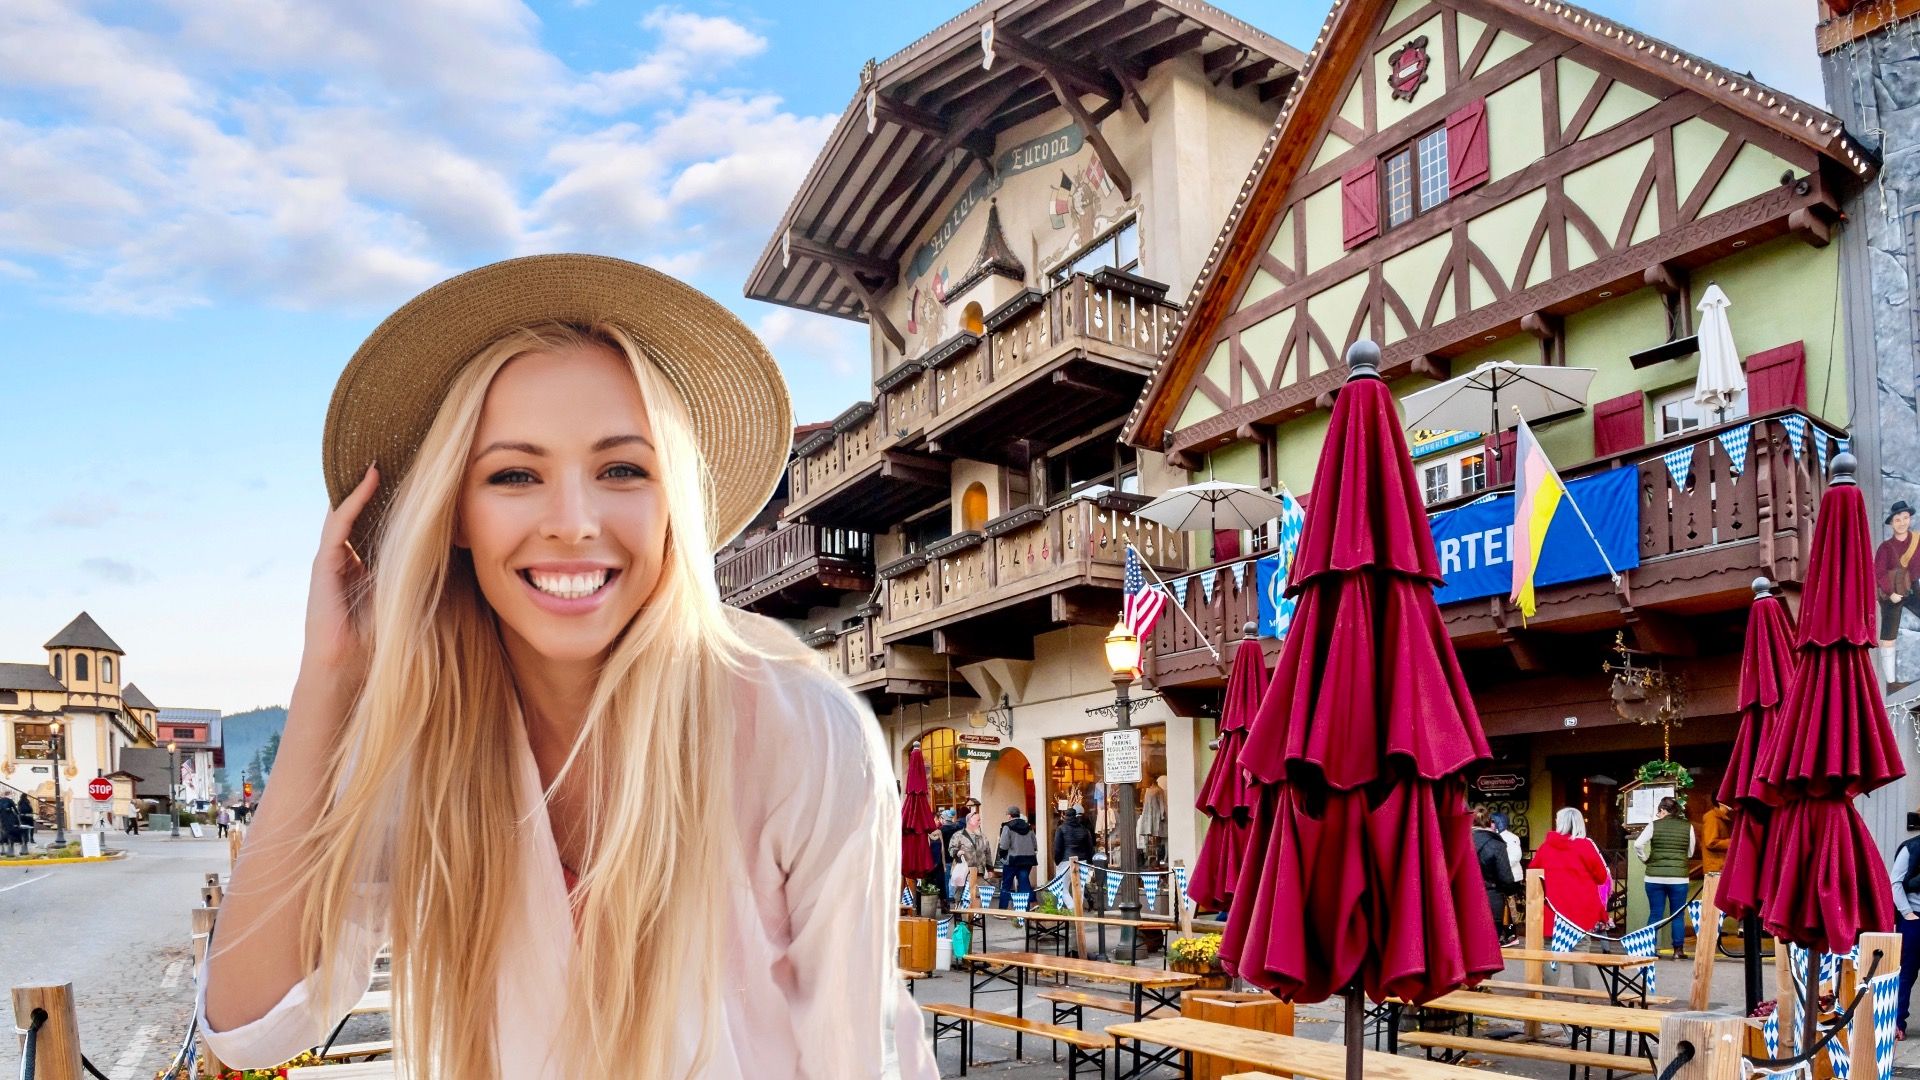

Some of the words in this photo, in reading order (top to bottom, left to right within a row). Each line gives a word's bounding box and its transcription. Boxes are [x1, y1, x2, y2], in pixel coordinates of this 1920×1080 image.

[931, 190, 975, 257] Hotel
[1012, 135, 1070, 169] Europa
[967, 749, 992, 759] Massage
[89, 784, 112, 794] STOP
